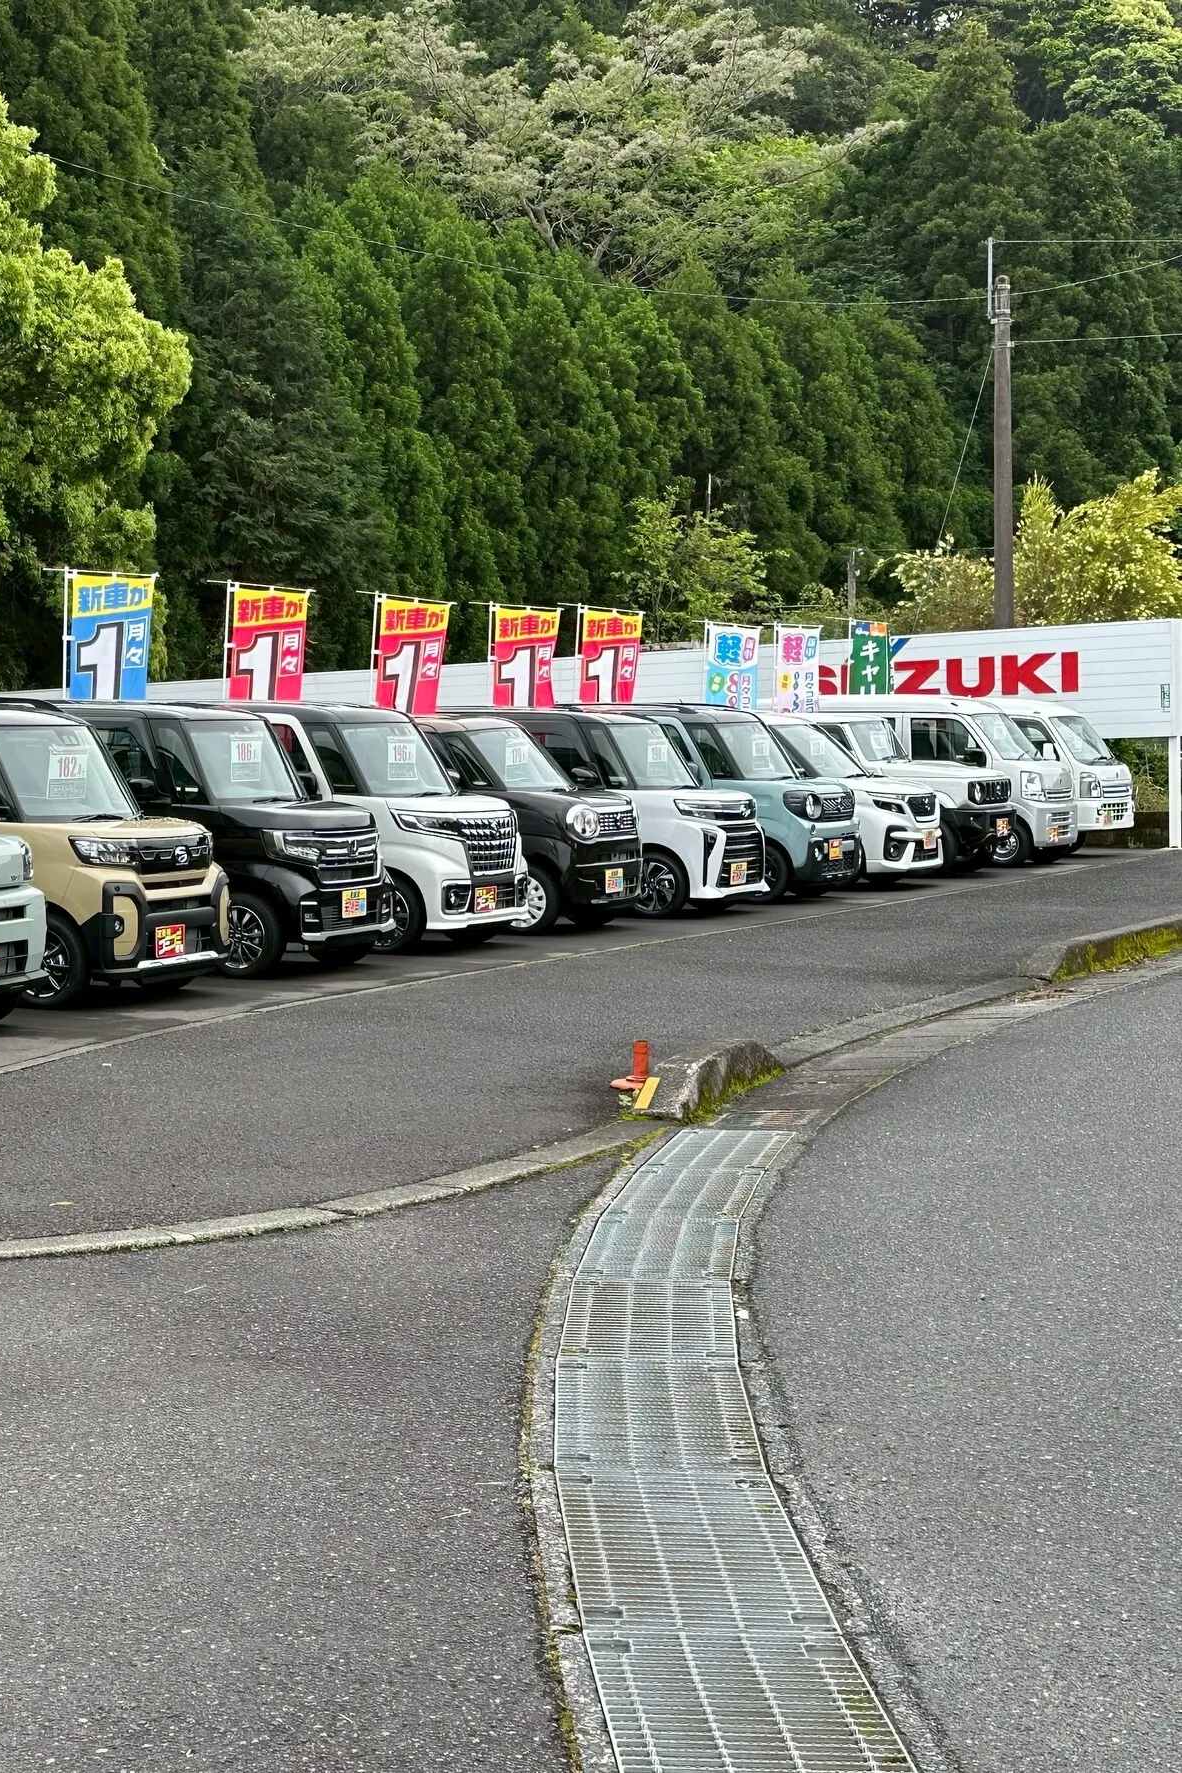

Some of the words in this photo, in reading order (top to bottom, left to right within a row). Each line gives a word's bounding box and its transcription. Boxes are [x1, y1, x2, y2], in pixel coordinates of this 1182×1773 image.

[78, 582, 149, 613] 新車が
[237, 595, 304, 623] 新車が
[385, 607, 445, 631] 新車が
[499, 614, 557, 638] 新車が
[587, 616, 638, 638] 新車が
[126, 622, 144, 665] 月々
[281, 633, 299, 672] 月々
[715, 634, 742, 664] 軽
[782, 635, 805, 663] 軽
[76, 621, 124, 700] 1
[236, 631, 280, 701] 1
[383, 641, 421, 713] 1
